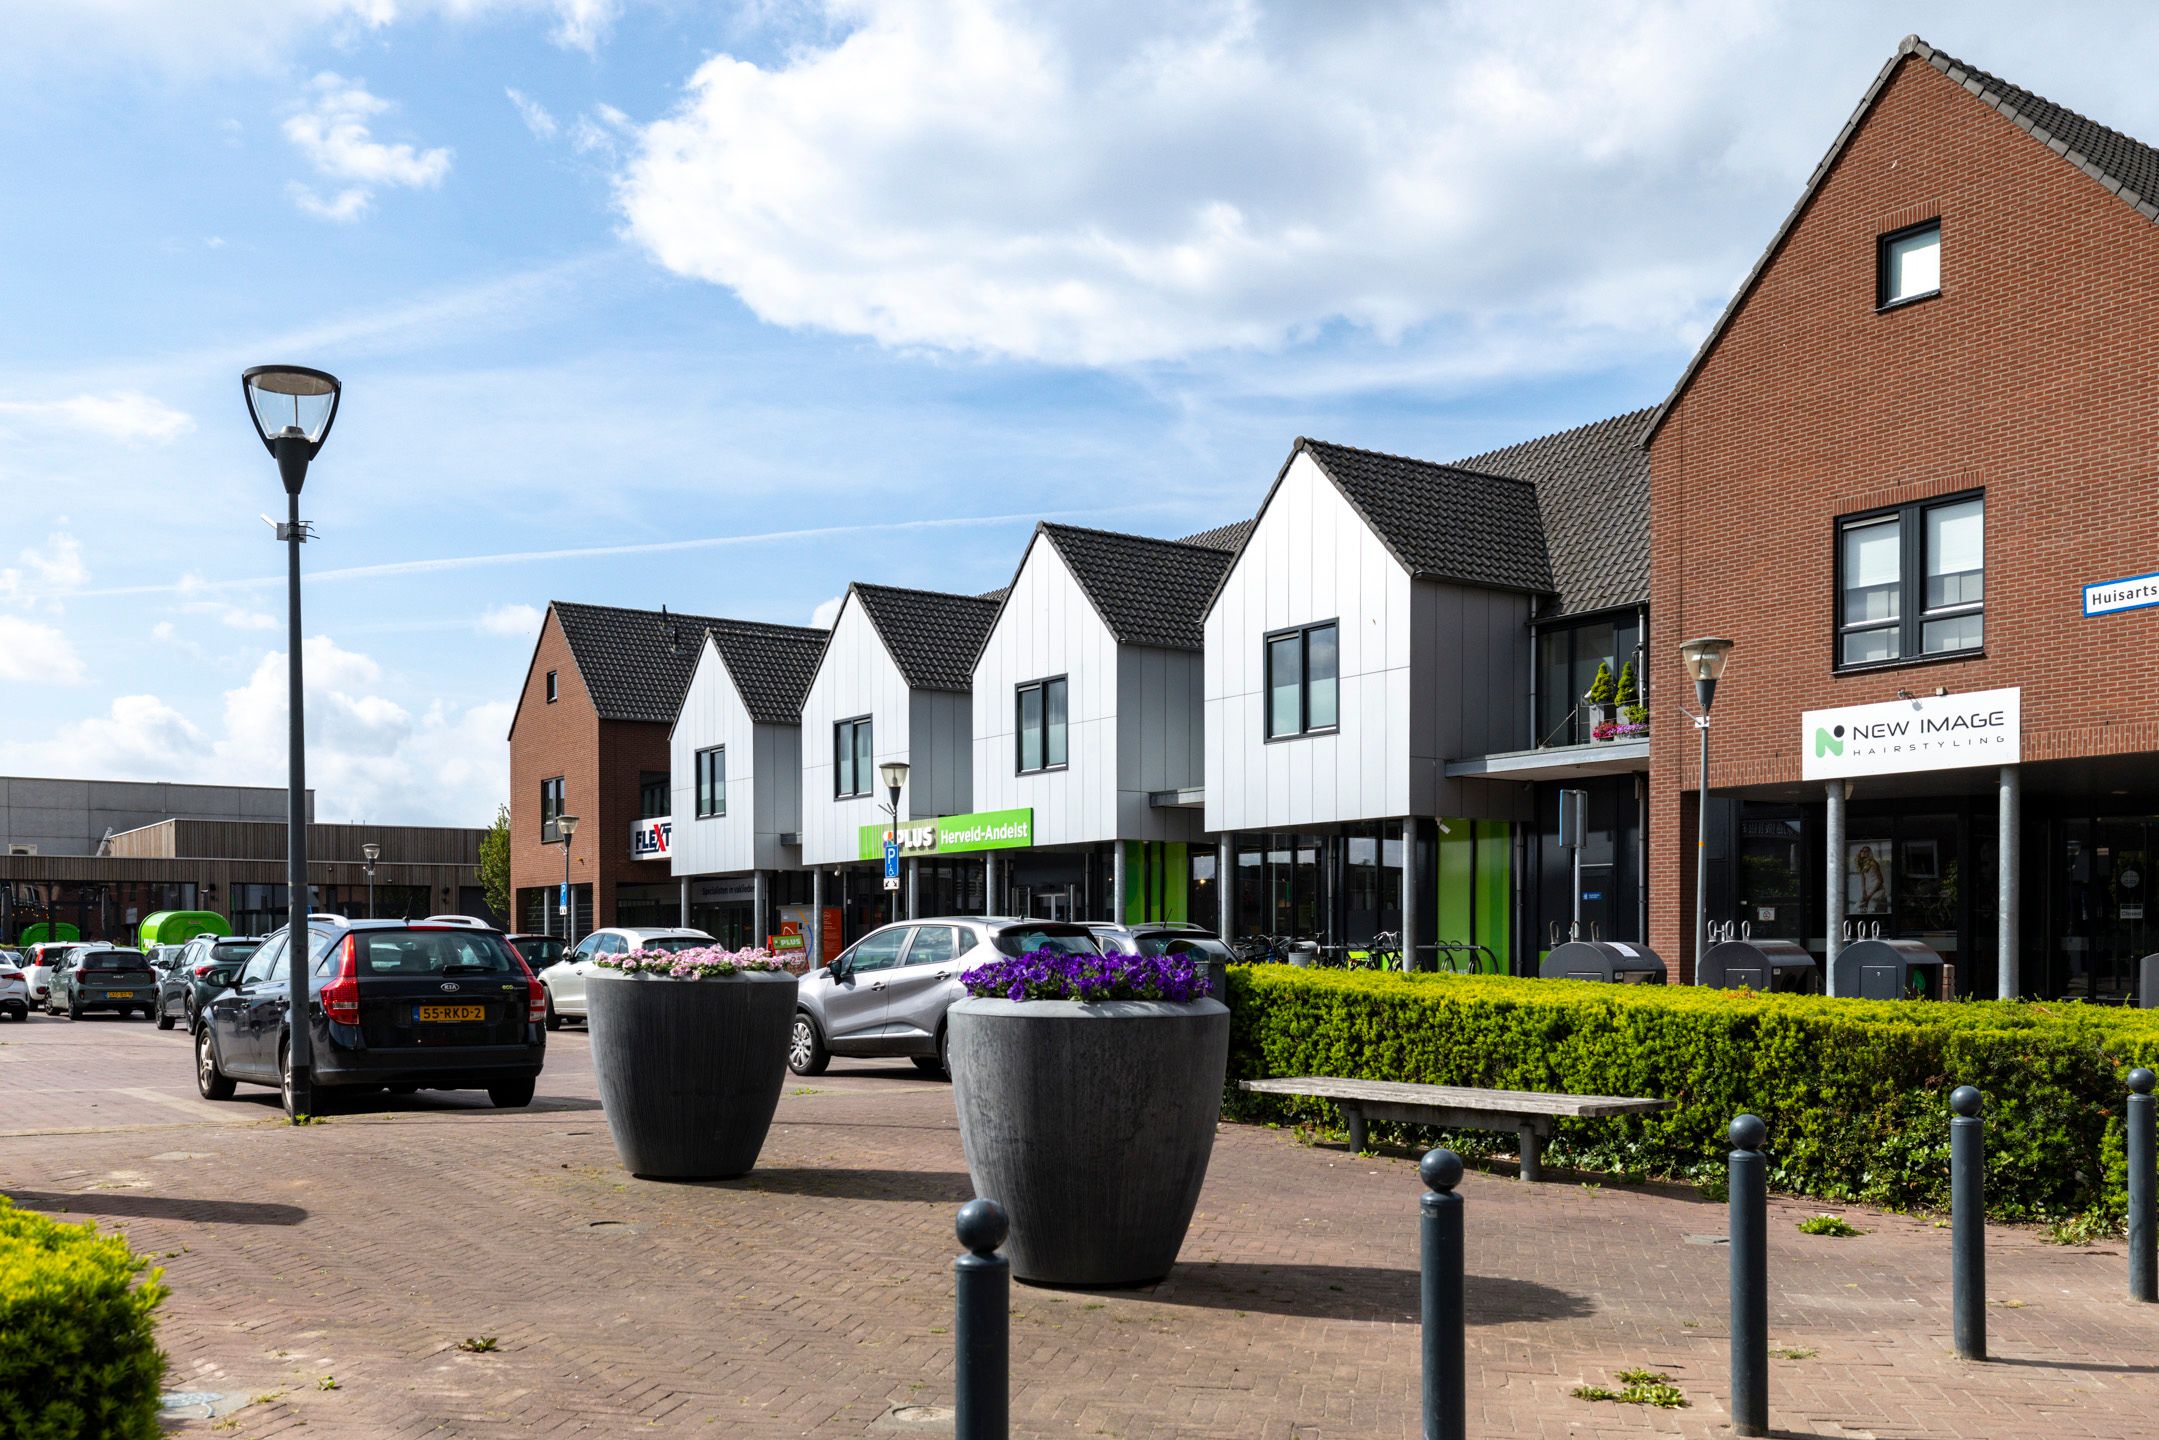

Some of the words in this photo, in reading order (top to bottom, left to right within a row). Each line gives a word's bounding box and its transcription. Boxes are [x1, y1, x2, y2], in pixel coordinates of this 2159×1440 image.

[2092, 585, 2158, 606] Huisarts
[1853, 721, 1910, 741] NEW
[1920, 711, 2005, 734] IMAGE
[1853, 735, 2005, 757] HAIRSTYLING
[897, 827, 933, 848] PLUS
[940, 822, 1028, 845] Herveld-Andelst
[887, 848, 896, 865] P
[423, 1007, 482, 1019] 55-RKD-2
